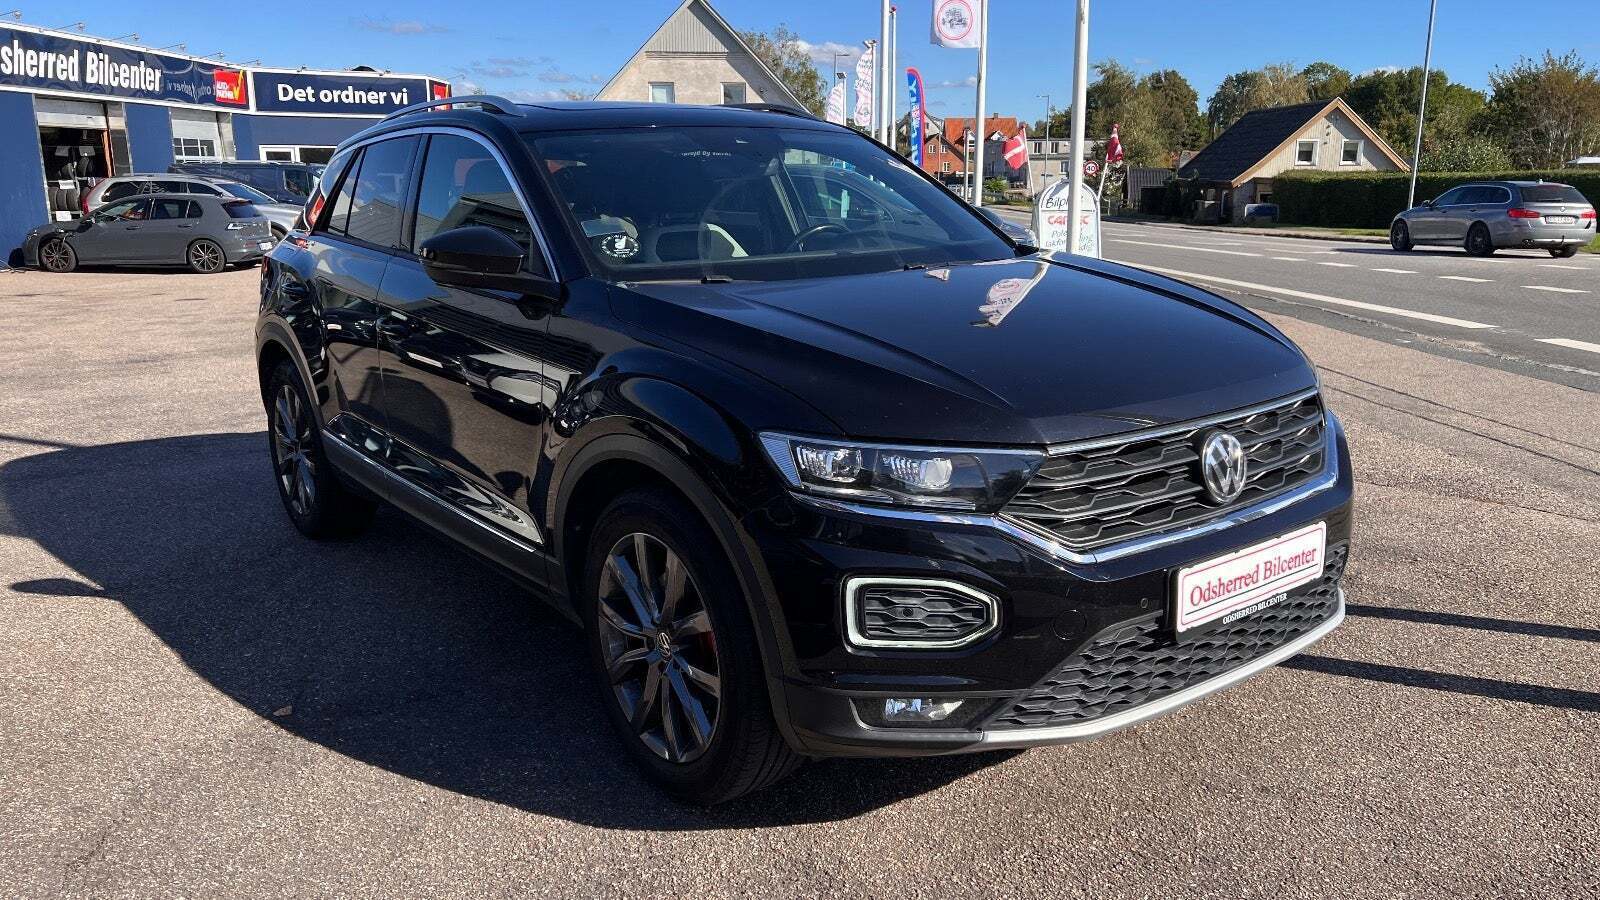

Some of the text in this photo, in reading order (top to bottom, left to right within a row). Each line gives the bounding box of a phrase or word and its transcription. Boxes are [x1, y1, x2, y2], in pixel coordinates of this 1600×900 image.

[0, 40, 79, 82] sherred
[86, 51, 161, 91] Bilcenter
[277, 84, 408, 105] Det ordner vi
[1190, 548, 1316, 606] Odsherred Bilcenter
[1222, 593, 1288, 624] ODSHERRED BILCENTER
